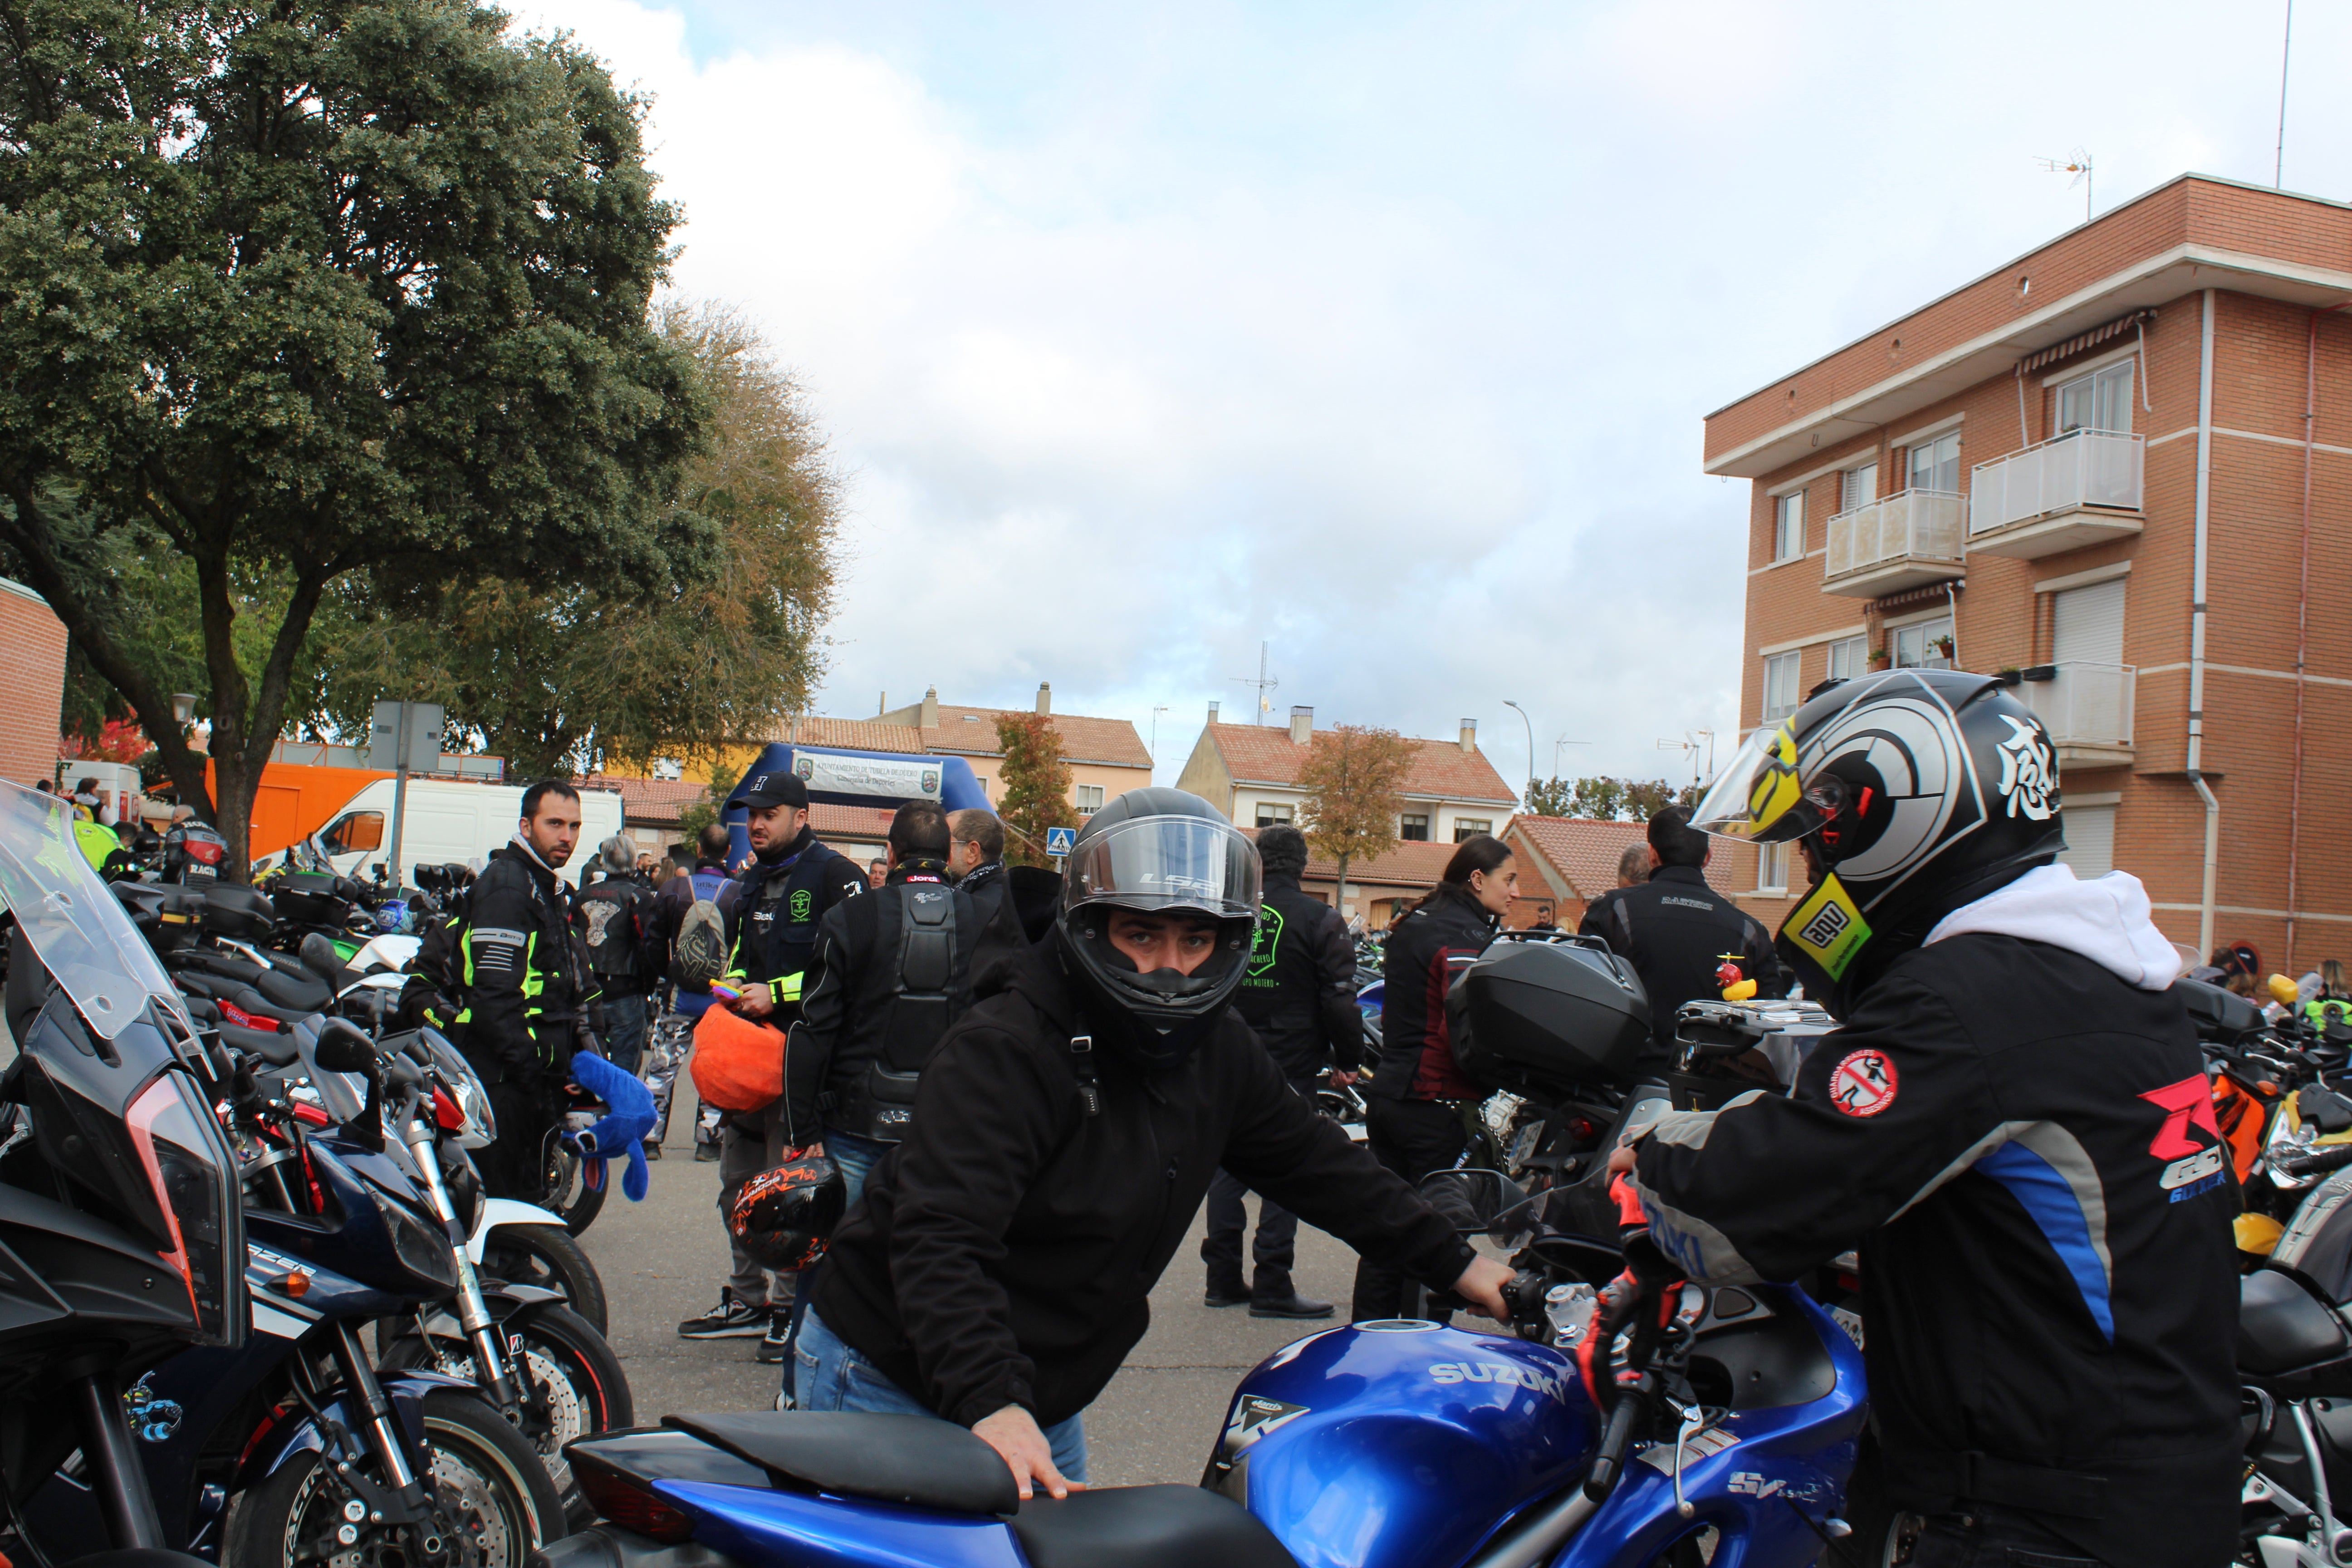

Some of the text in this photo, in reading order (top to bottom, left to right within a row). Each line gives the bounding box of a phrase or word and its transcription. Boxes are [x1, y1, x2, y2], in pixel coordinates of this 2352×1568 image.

[818, 763, 860, 772] AYUNTAMIENTO
[869, 767, 890, 775] TUDELA
[872, 778, 895, 787] Deportes
[1139, 873, 1220, 892] LS2
[1661, 897, 1713, 911] RAINERS
[269, 954, 301, 970] HONDA
[1250, 954, 1270, 963] ACHERO
[1254, 979, 1274, 988] MOTERO
[1642, 1197, 1710, 1279] ZUKI
[248, 1243, 317, 1277] AZER
[1428, 1362, 1566, 1405] SUZUKI
[1728, 1471, 1788, 1499] SV
